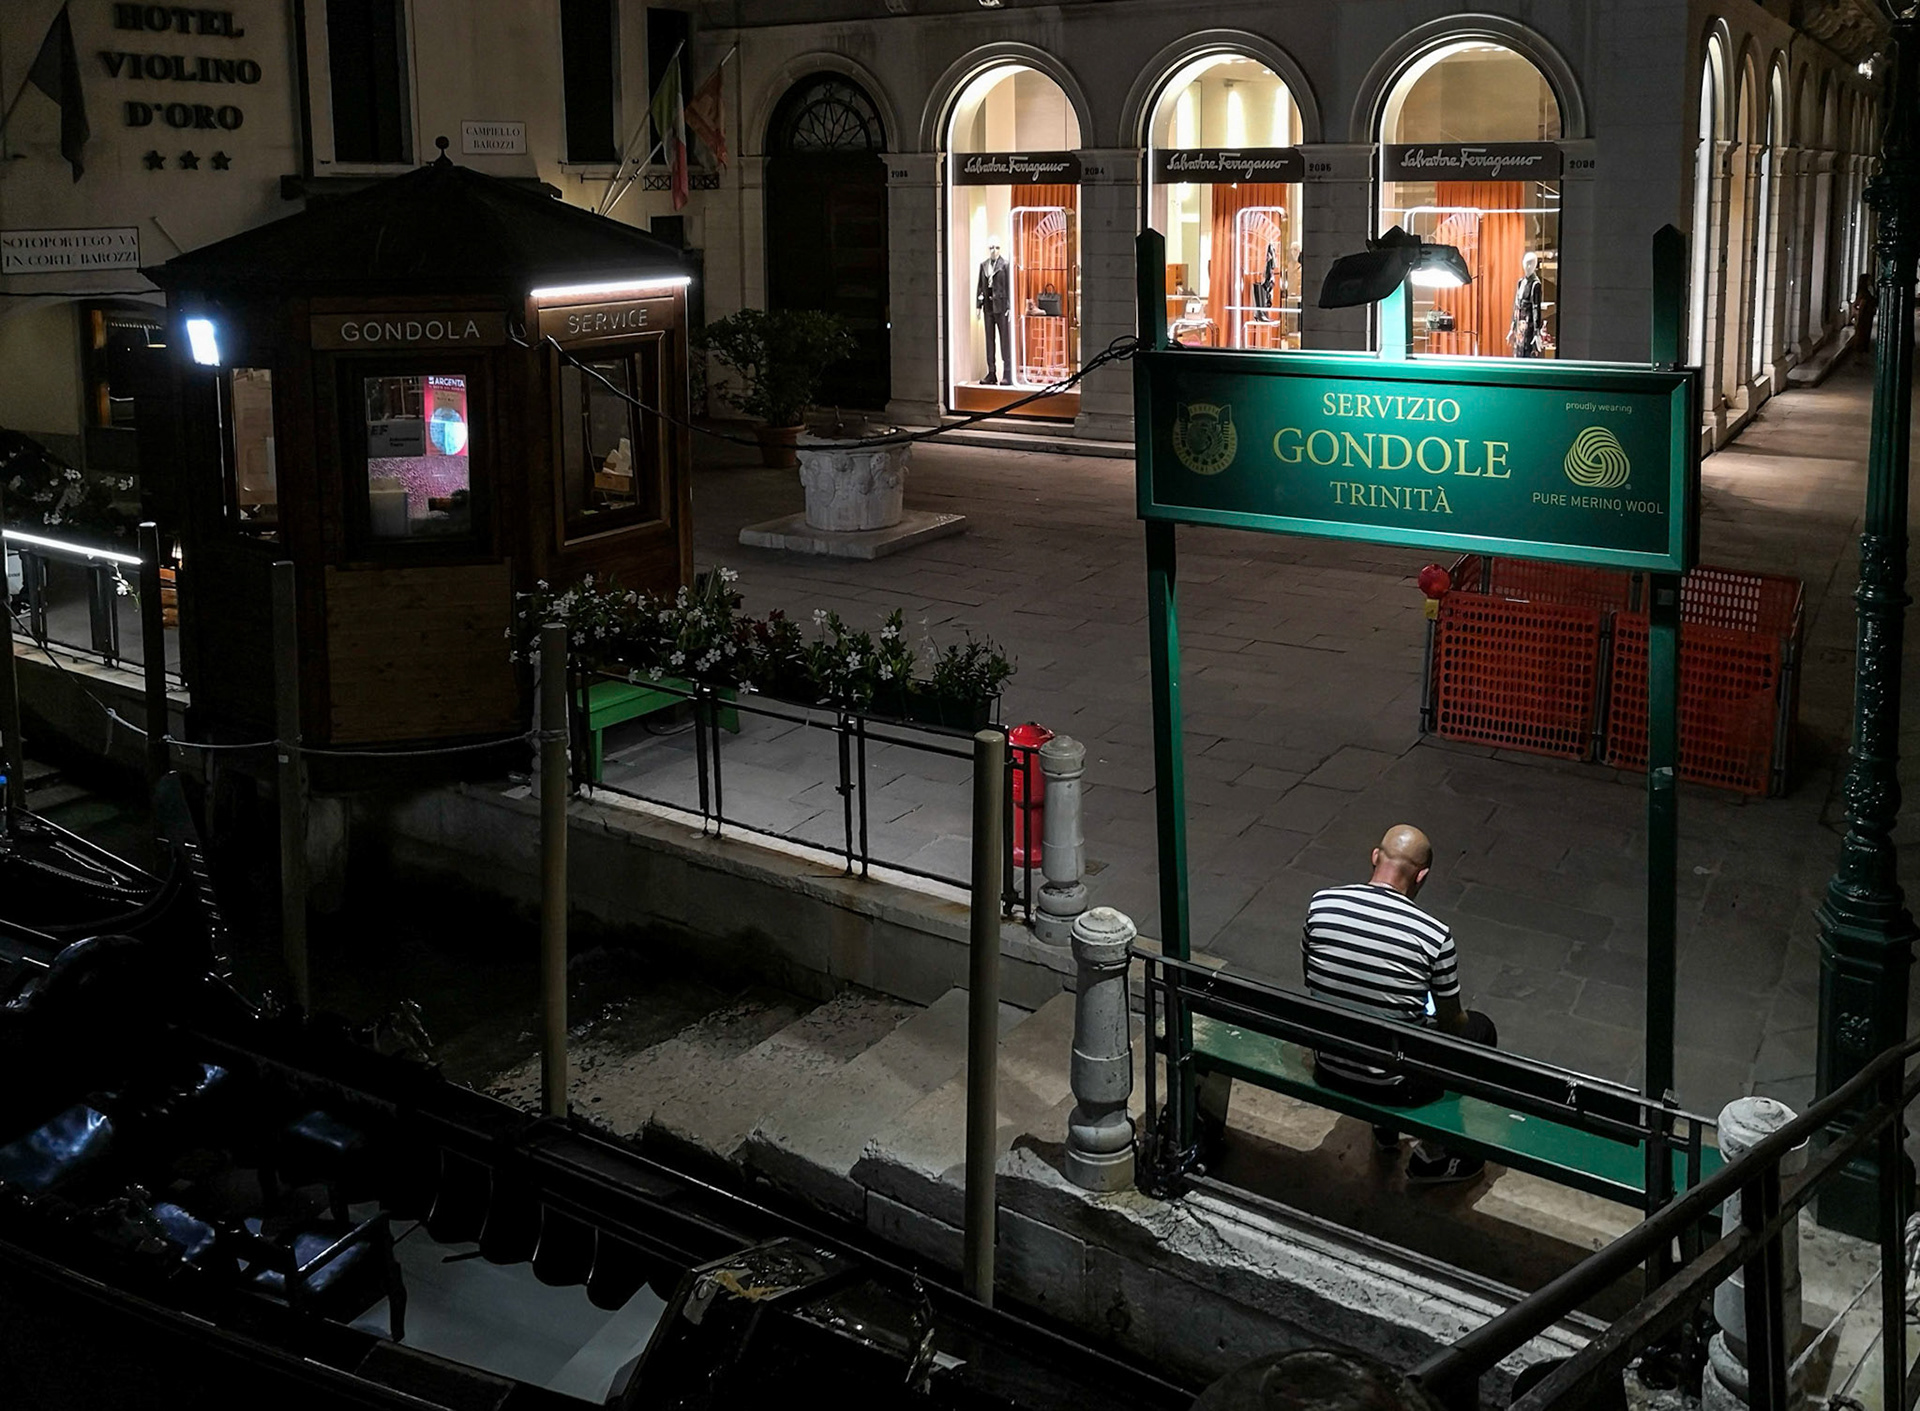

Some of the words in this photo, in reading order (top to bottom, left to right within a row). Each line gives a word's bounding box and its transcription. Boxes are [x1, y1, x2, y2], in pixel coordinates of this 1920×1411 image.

[114, 3, 244, 38] HOTEL
[98, 51, 262, 84] VIOLINO
[125, 101, 243, 130] D'ORO
[466, 127, 520, 137] CAMPIELLO
[473, 140, 514, 149] BAROZZI
[963, 156, 1008, 173] Salvatore
[1009, 156, 1070, 181] Ferragamo
[1167, 153, 1218, 171] Salvatore
[1218, 152, 1289, 179] Ferragamo
[1400, 149, 1459, 168] Salvatore
[1460, 148, 1542, 177] Ferragamo
[81, 251, 137, 264] BAROZZI
[341, 321, 480, 341] GONDOLA
[568, 309, 648, 334] SERVICE
[435, 377, 465, 388] ARGENTA
[1322, 392, 1461, 423] SERVIZIO
[1565, 402, 1597, 412] proudly
[1598, 404, 1632, 414] wearing
[1272, 427, 1512, 479] GONDOLE
[1329, 480, 1453, 514] TRINITÀ
[1532, 492, 1567, 506] PURE
[1571, 496, 1621, 510] MERINO
[1625, 500, 1664, 515] WOOL
